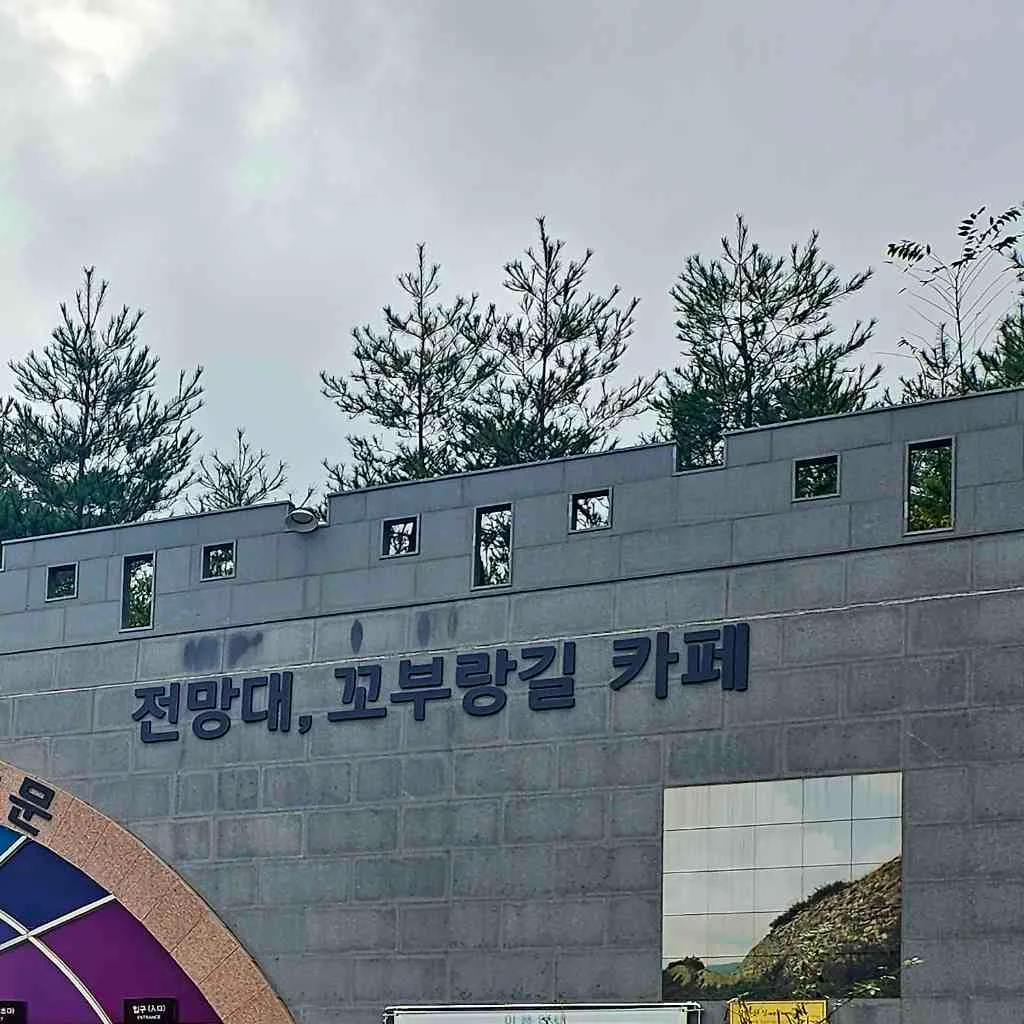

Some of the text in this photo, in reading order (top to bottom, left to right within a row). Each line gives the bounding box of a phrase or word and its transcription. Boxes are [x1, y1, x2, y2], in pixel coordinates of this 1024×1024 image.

[131, 623, 750, 744] 전망대, 꼬부랑길 카페
